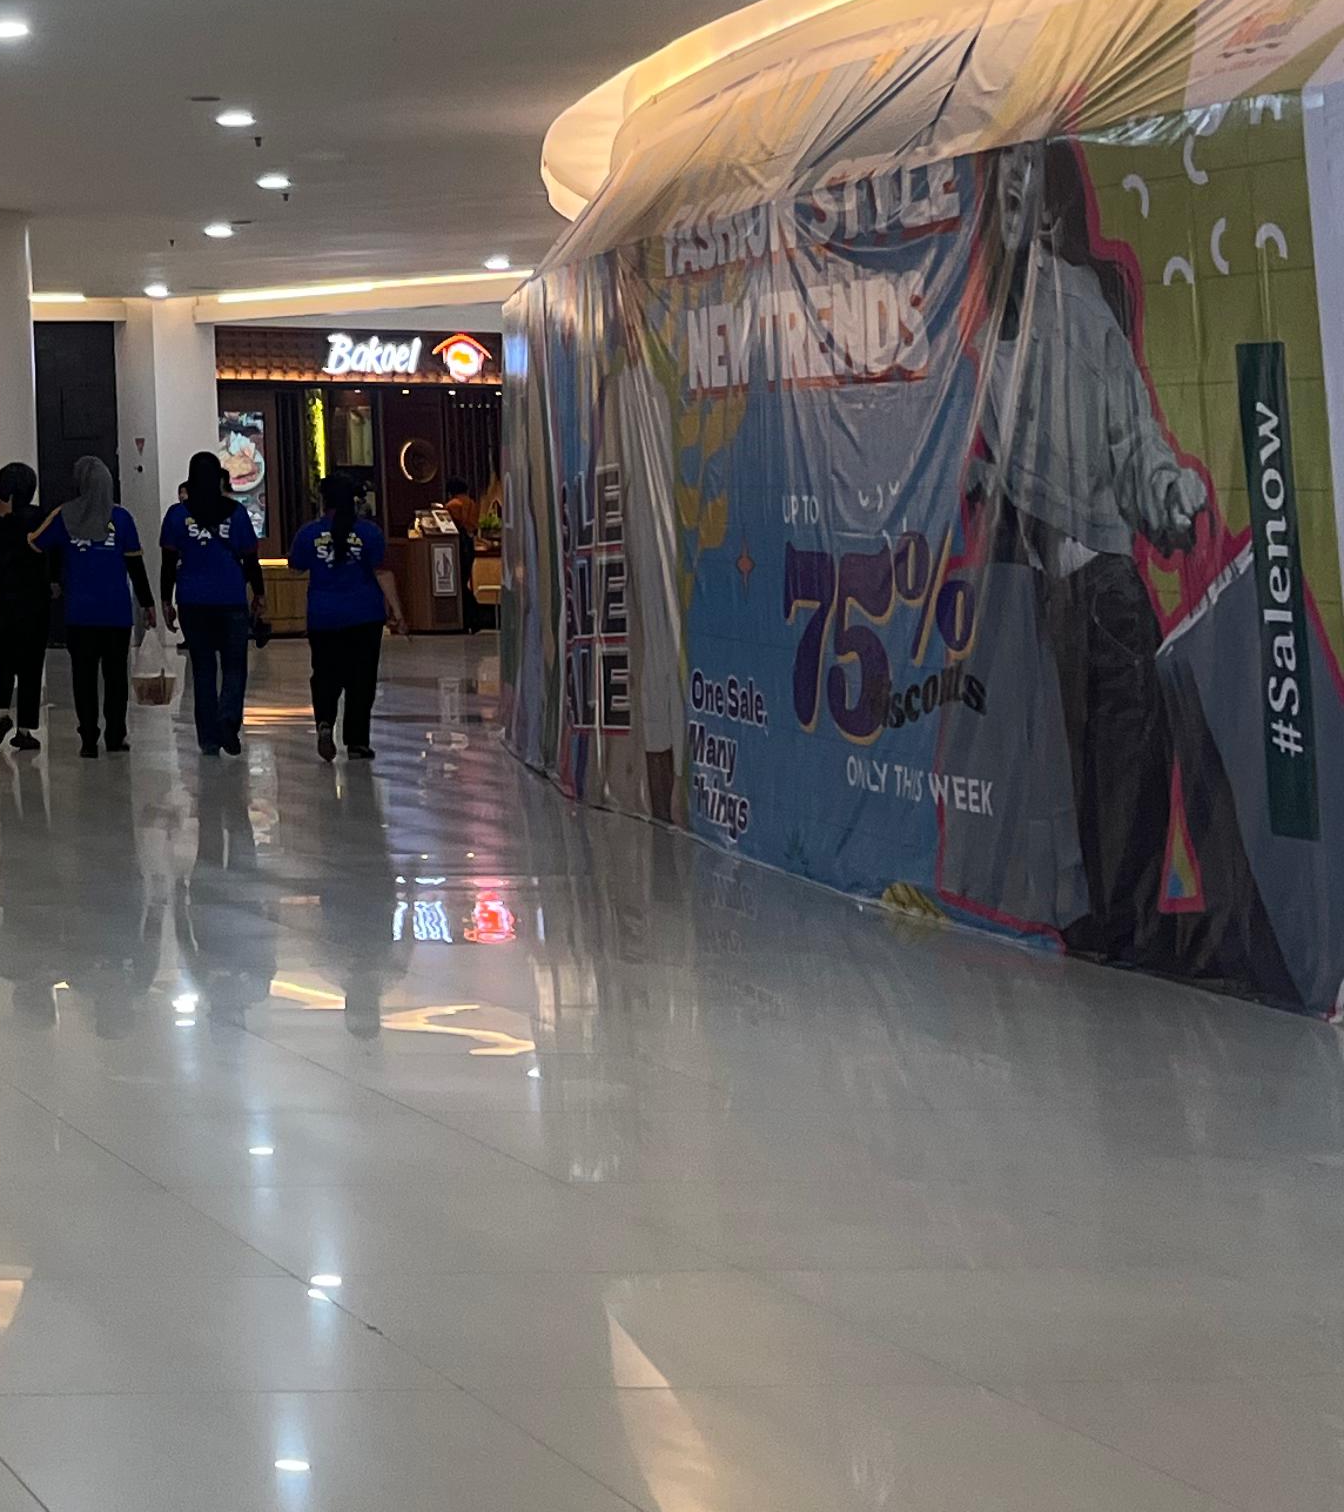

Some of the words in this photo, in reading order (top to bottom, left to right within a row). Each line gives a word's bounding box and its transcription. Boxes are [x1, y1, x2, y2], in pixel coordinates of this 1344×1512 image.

[321, 333, 422, 375] Bakoel
[686, 304, 752, 389] NEW
[759, 269, 930, 381] TRENDS
[188, 523, 231, 540] SAE
[781, 495, 800, 526] UP
[801, 494, 820, 525] TO
[1255, 401, 1305, 757] #Salenow
[782, 522, 976, 746] 75%
[691, 668, 724, 718] One
[688, 720, 738, 787] Many
[893, 763, 925, 803] THIS
[927, 771, 994, 817] WEEK
